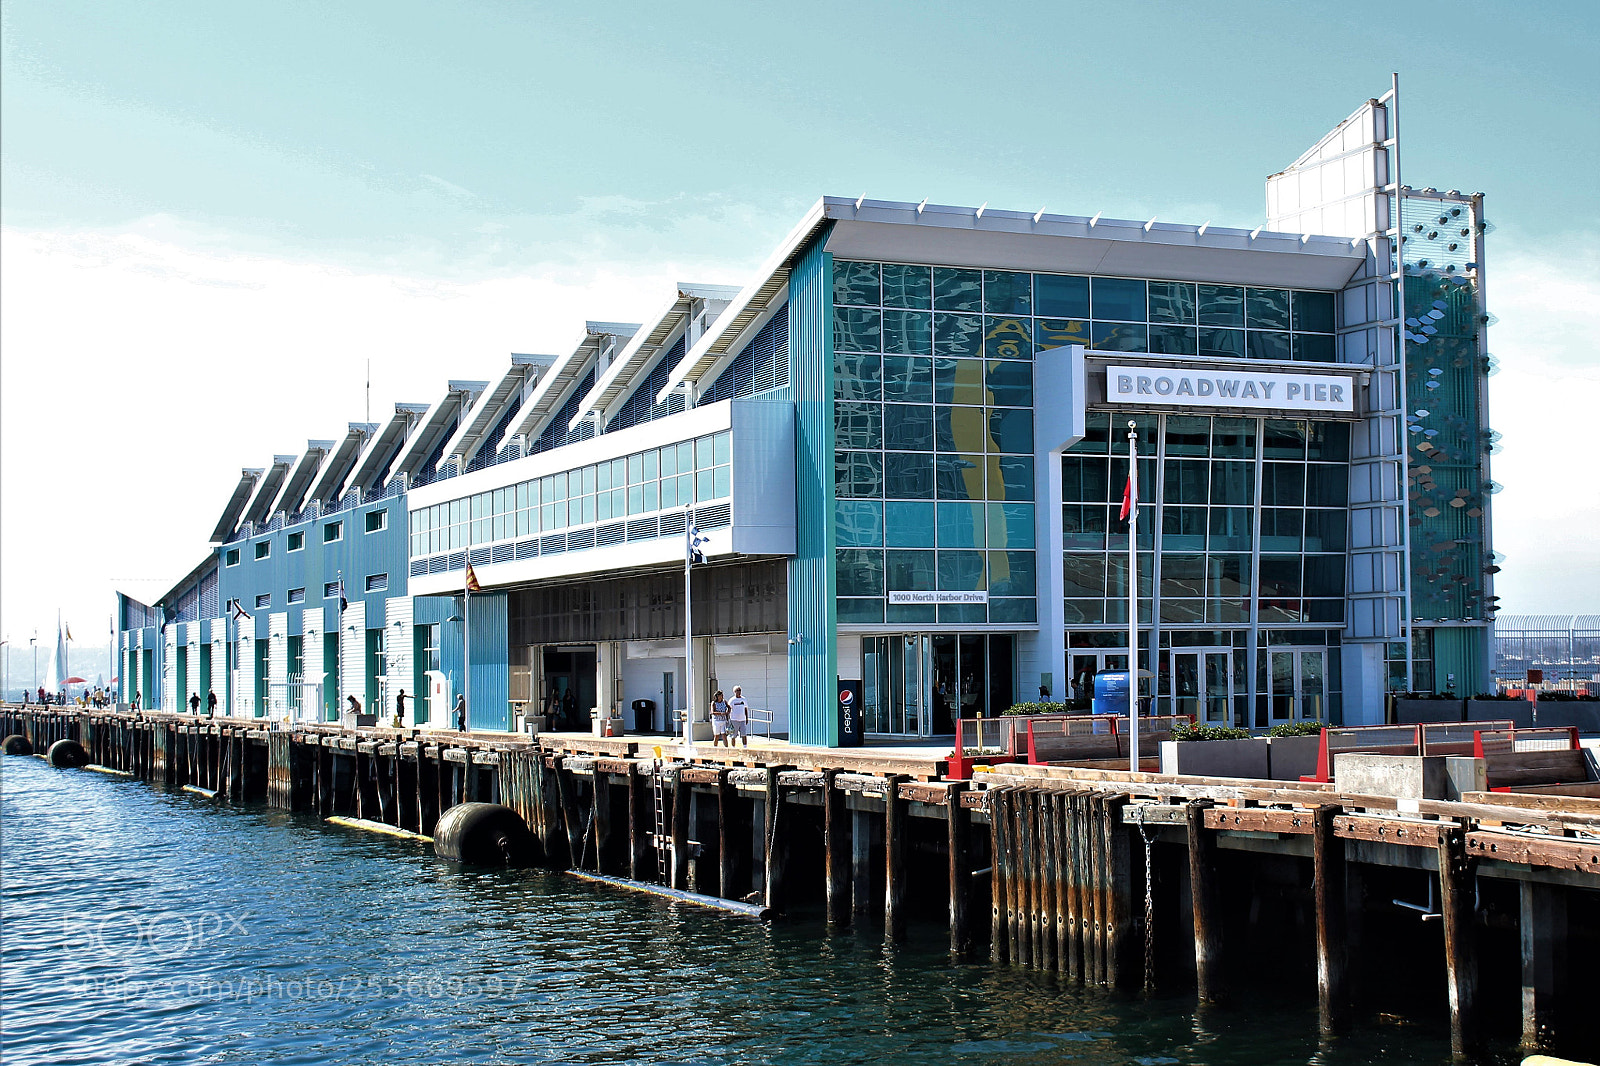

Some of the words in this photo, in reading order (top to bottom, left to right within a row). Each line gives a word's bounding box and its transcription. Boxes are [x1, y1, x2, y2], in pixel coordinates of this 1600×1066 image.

[1117, 374, 1276, 400] BROADWAY
[1286, 382, 1344, 403] PIER
[893, 593, 911, 601] 1000
[912, 593, 934, 601] North
[936, 594, 961, 602] Harbor
[963, 594, 984, 602] Drive
[842, 706, 852, 733] pepsi
